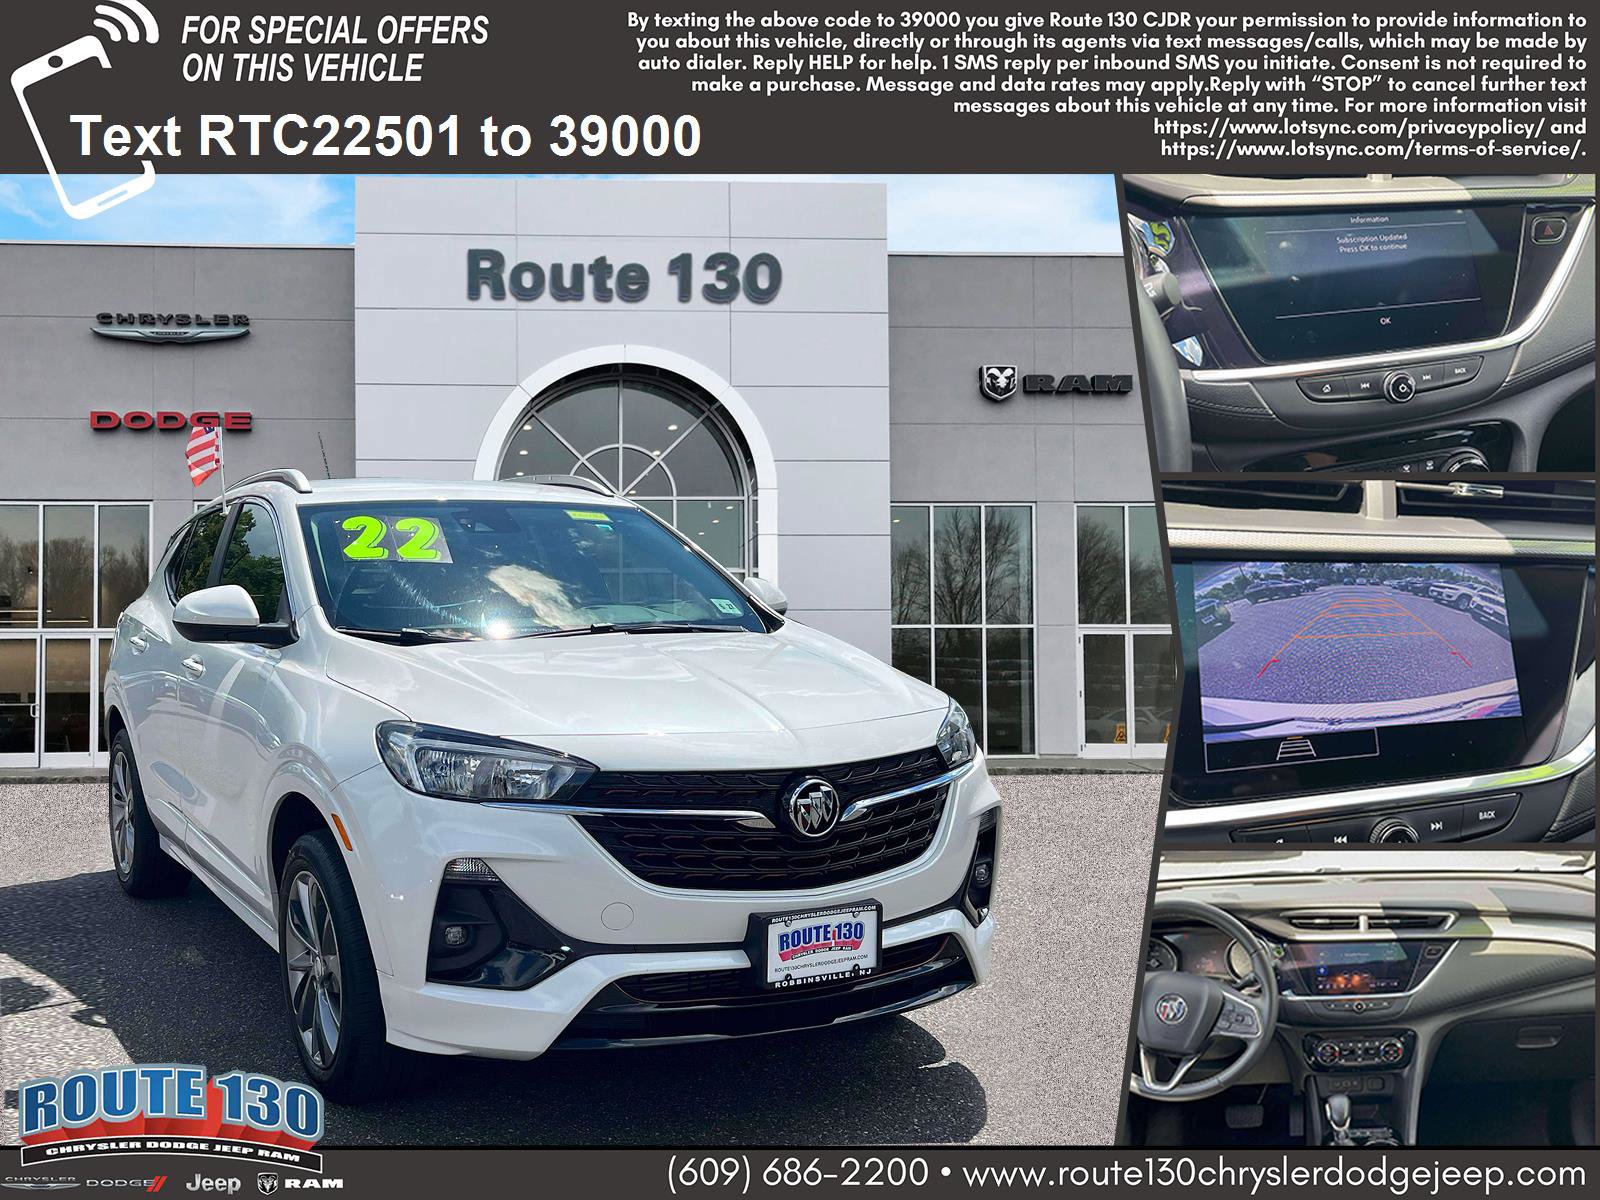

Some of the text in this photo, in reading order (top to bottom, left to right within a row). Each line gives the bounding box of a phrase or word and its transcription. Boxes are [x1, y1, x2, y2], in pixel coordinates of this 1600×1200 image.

[1350, 215, 1390, 224] Information
[1379, 233, 1408, 242] Updated
[467, 248, 783, 305] Route 130
[96, 312, 250, 326] CHRYSLER
[1380, 316, 1392, 325] OK
[1022, 374, 1134, 394] RAM
[89, 410, 254, 432] DODGE
[341, 515, 442, 560] 22
[1478, 810, 1496, 821] BACK
[779, 922, 864, 952] ROUTE 130
[859, 968, 873, 977] NJ
